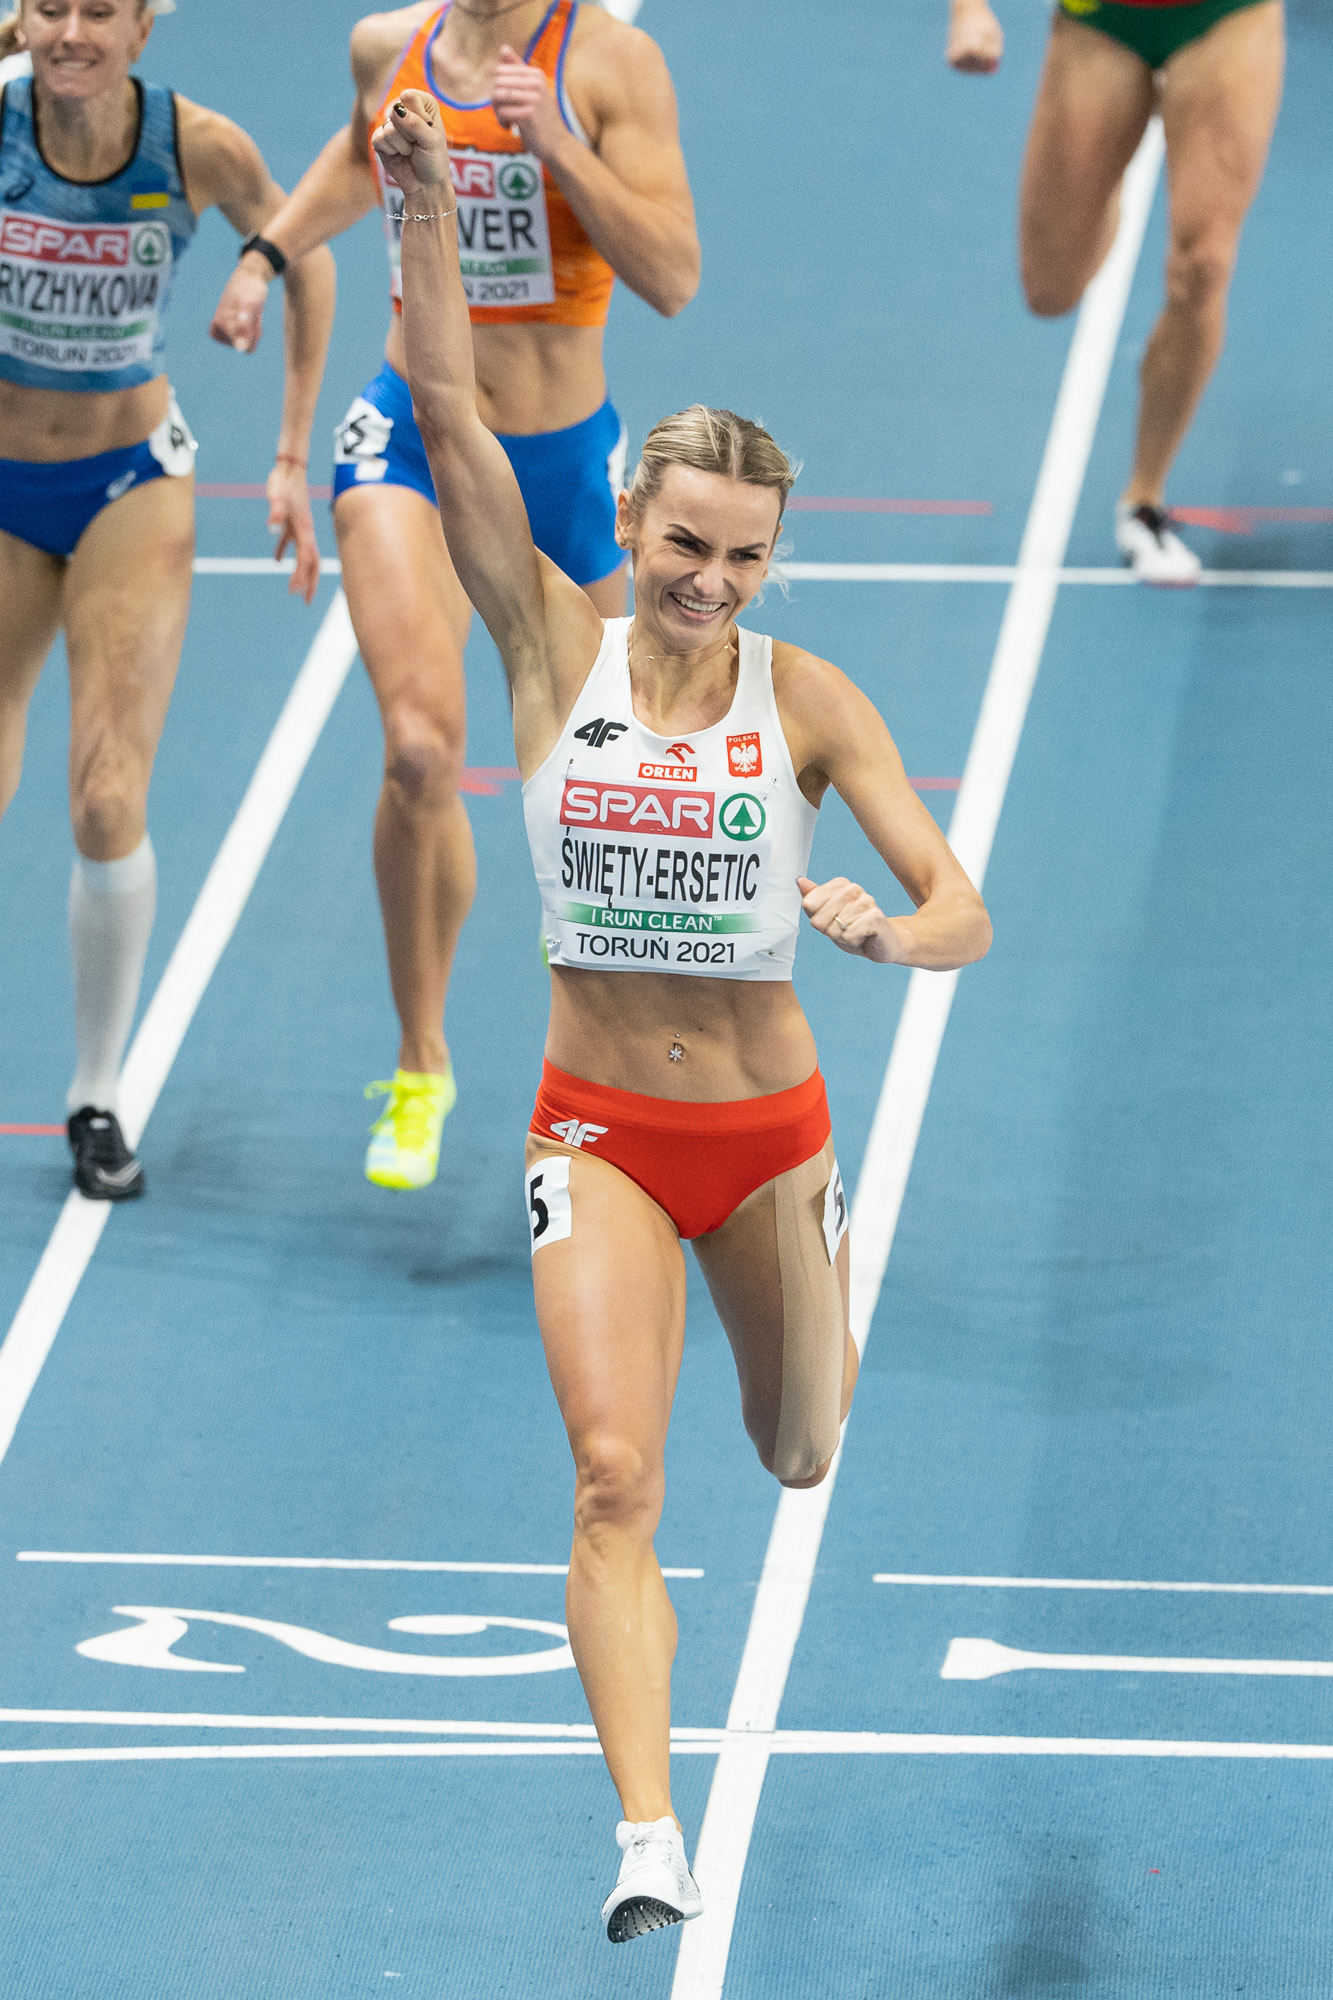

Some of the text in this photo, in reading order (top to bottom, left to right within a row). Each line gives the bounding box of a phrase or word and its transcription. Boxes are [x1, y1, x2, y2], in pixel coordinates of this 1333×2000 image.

[3, 222, 126, 261] SPAR
[574, 718, 629, 748] 4F
[727, 732, 758, 744] POLSKA
[641, 766, 695, 780] ORLEN
[565, 786, 709, 832] SPAR
[561, 826, 760, 909] ŚWIĘTY-ERSETIC
[591, 908, 597, 924] I
[601, 910, 643, 928] RUN
[576, 933, 735, 964] TORUŃ 2021
[550, 1119, 609, 1148] 4F
[530, 1173, 549, 1242] 5
